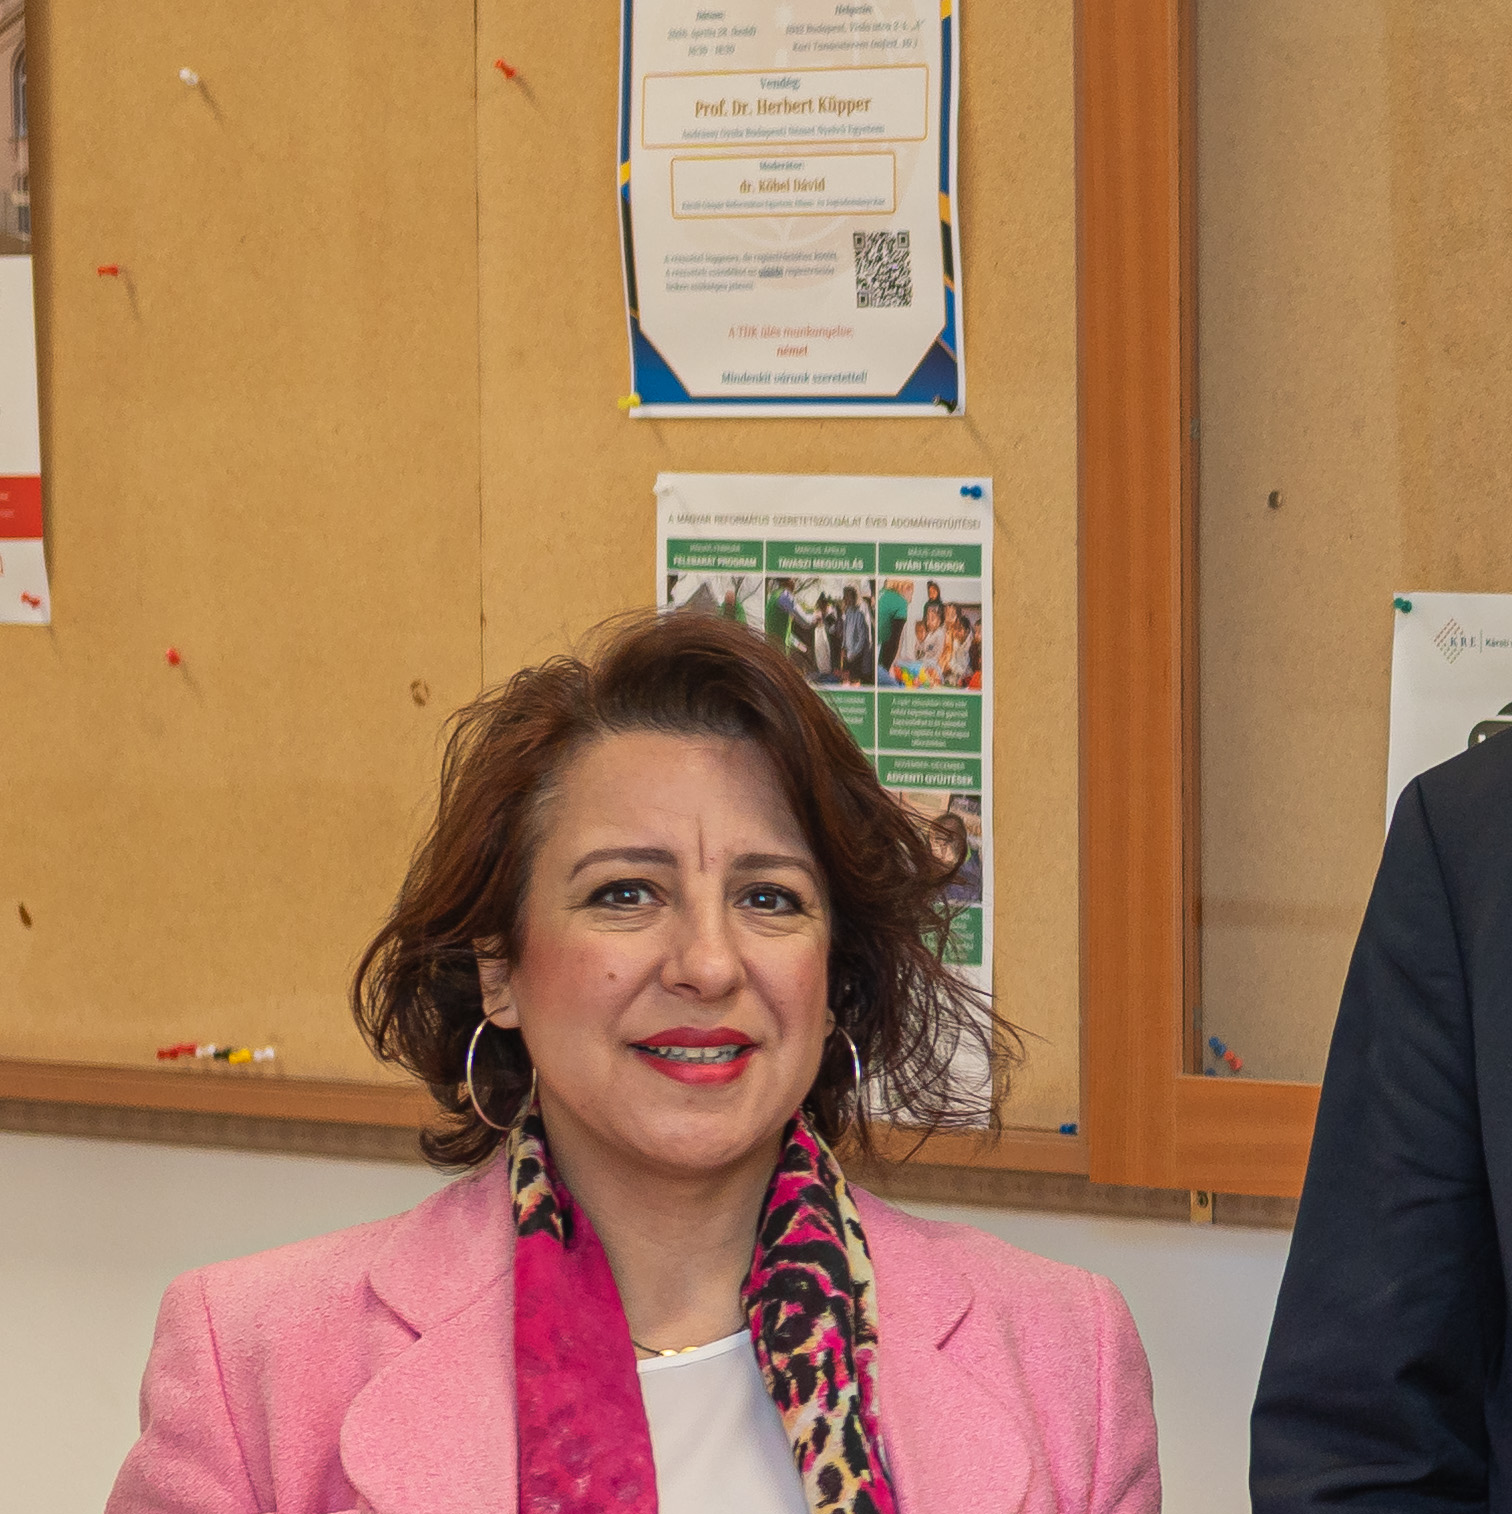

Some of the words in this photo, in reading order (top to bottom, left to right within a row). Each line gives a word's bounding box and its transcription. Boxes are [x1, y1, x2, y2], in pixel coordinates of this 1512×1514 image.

[694, 98, 727, 118] Prof.
[732, 100, 752, 116] Dr.
[756, 96, 814, 115] Herbert
[1450, 637, 1477, 647] KRE
[1485, 638, 1509, 647] Károli
